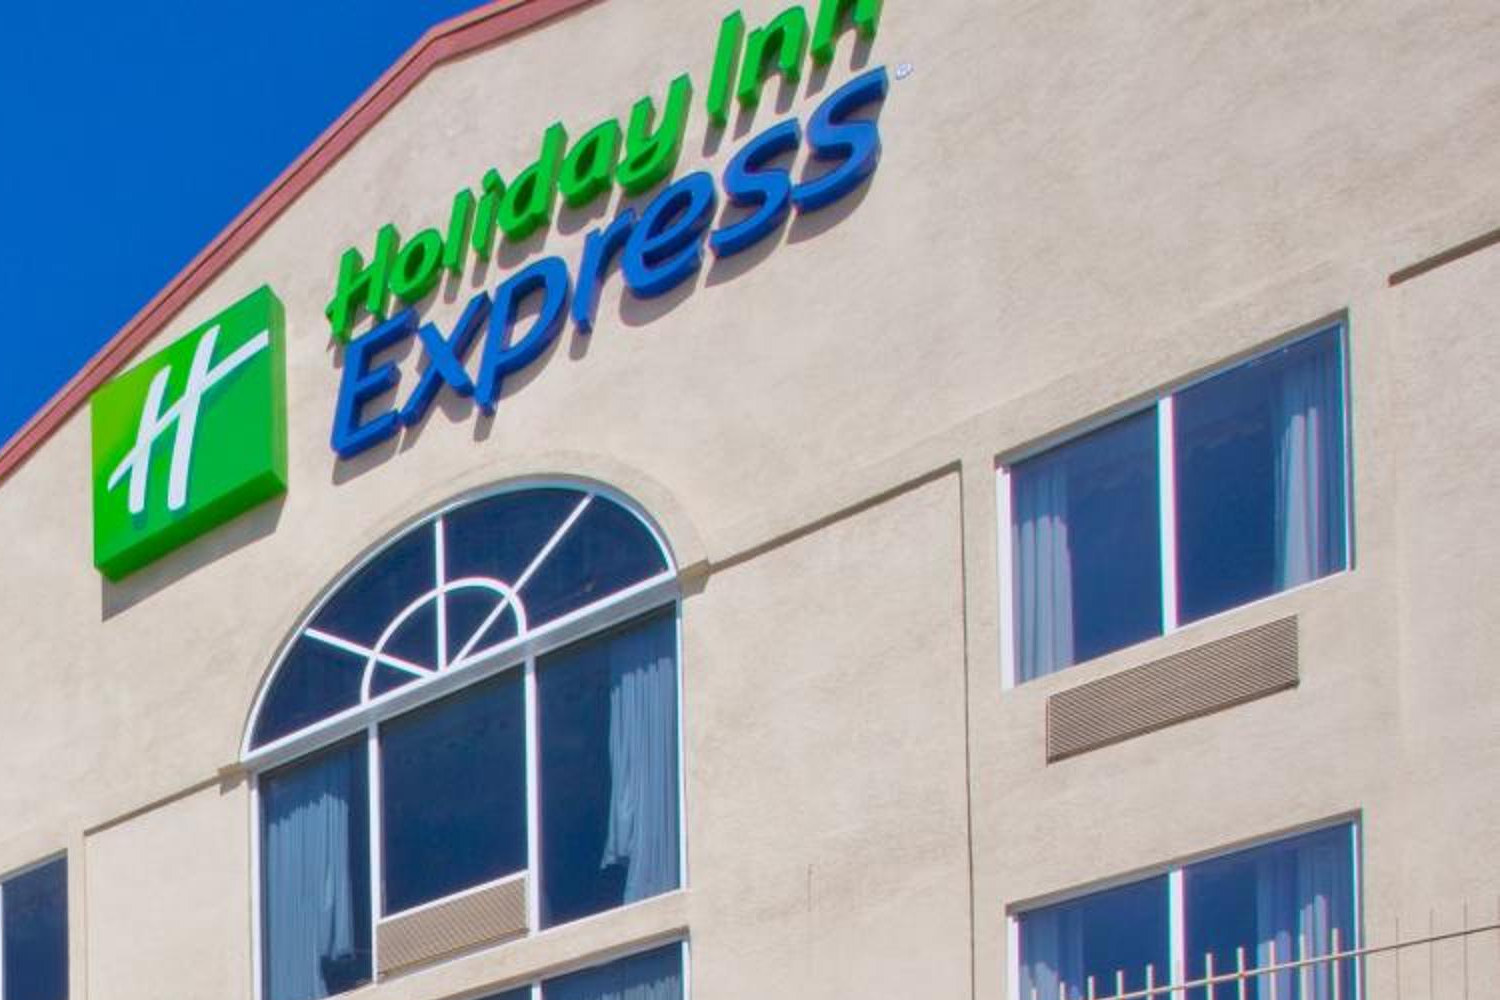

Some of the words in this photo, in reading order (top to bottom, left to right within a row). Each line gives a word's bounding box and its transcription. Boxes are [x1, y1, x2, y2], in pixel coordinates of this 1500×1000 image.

[326, 74, 692, 343] Holiday
[706, 0, 884, 128] Inn
[331, 65, 888, 459] Express
